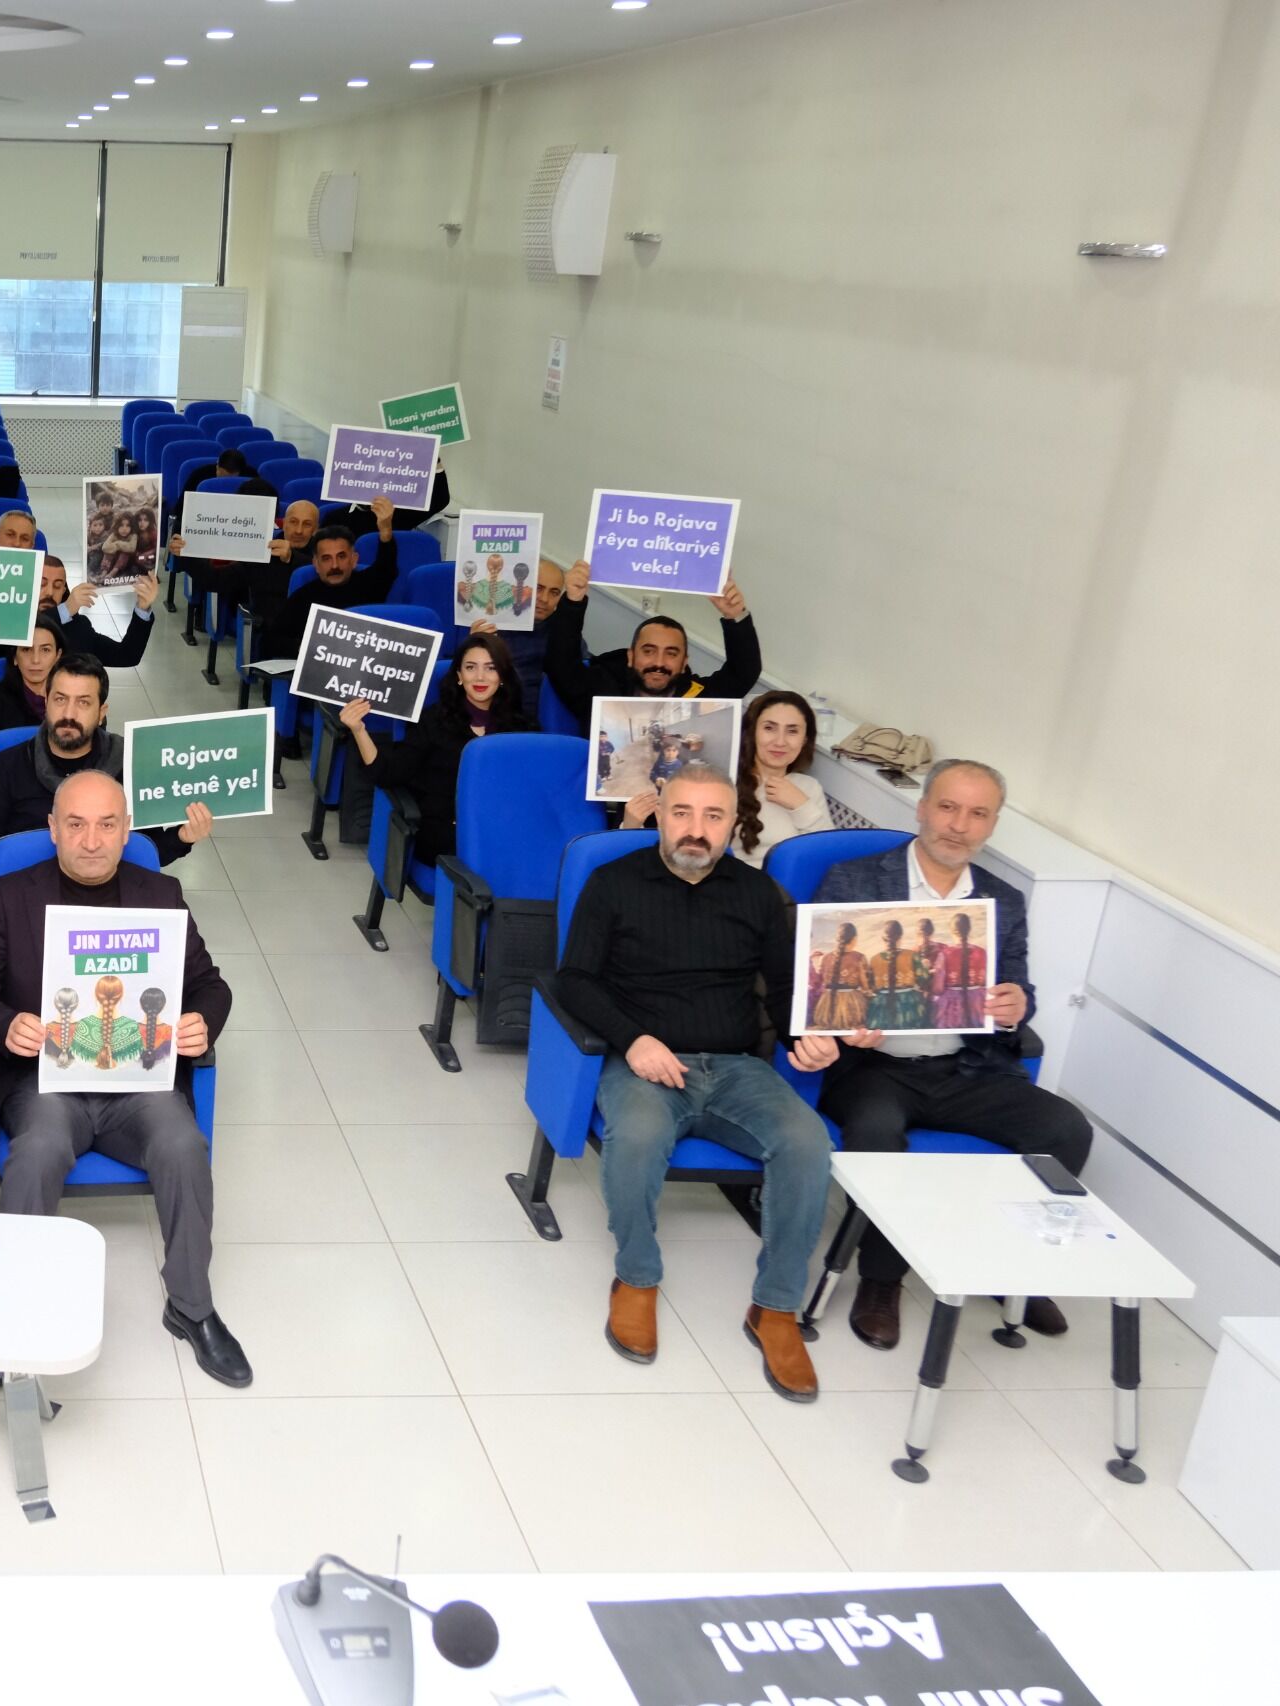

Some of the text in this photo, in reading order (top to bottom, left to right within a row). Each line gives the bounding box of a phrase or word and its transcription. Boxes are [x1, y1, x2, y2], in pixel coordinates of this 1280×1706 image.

[420, 405, 455, 421] yardım
[354, 443, 413, 461] Rojava’ya
[334, 460, 429, 479] yardım koridoru
[340, 475, 418, 494] hemen şimdi!
[196, 513, 257, 527] Sınırlar değil,
[608, 508, 718, 531] Ji bo Rojava
[185, 526, 219, 536] insanlık
[475, 527, 524, 538] JIN JIYAN
[598, 533, 638, 550] rêya
[632, 560, 680, 576] veke!
[317, 618, 427, 658] Mürşitpınar
[314, 645, 416, 683] Sınır Kapısı
[325, 675, 392, 703] Açılsın!
[161, 745, 238, 770] Rojava
[139, 768, 258, 801] ne tenê ye!
[73, 932, 155, 950] JIN JIYAN
[84, 953, 138, 973] AZADÎ
[700, 1602, 945, 1673] Açılsın!
